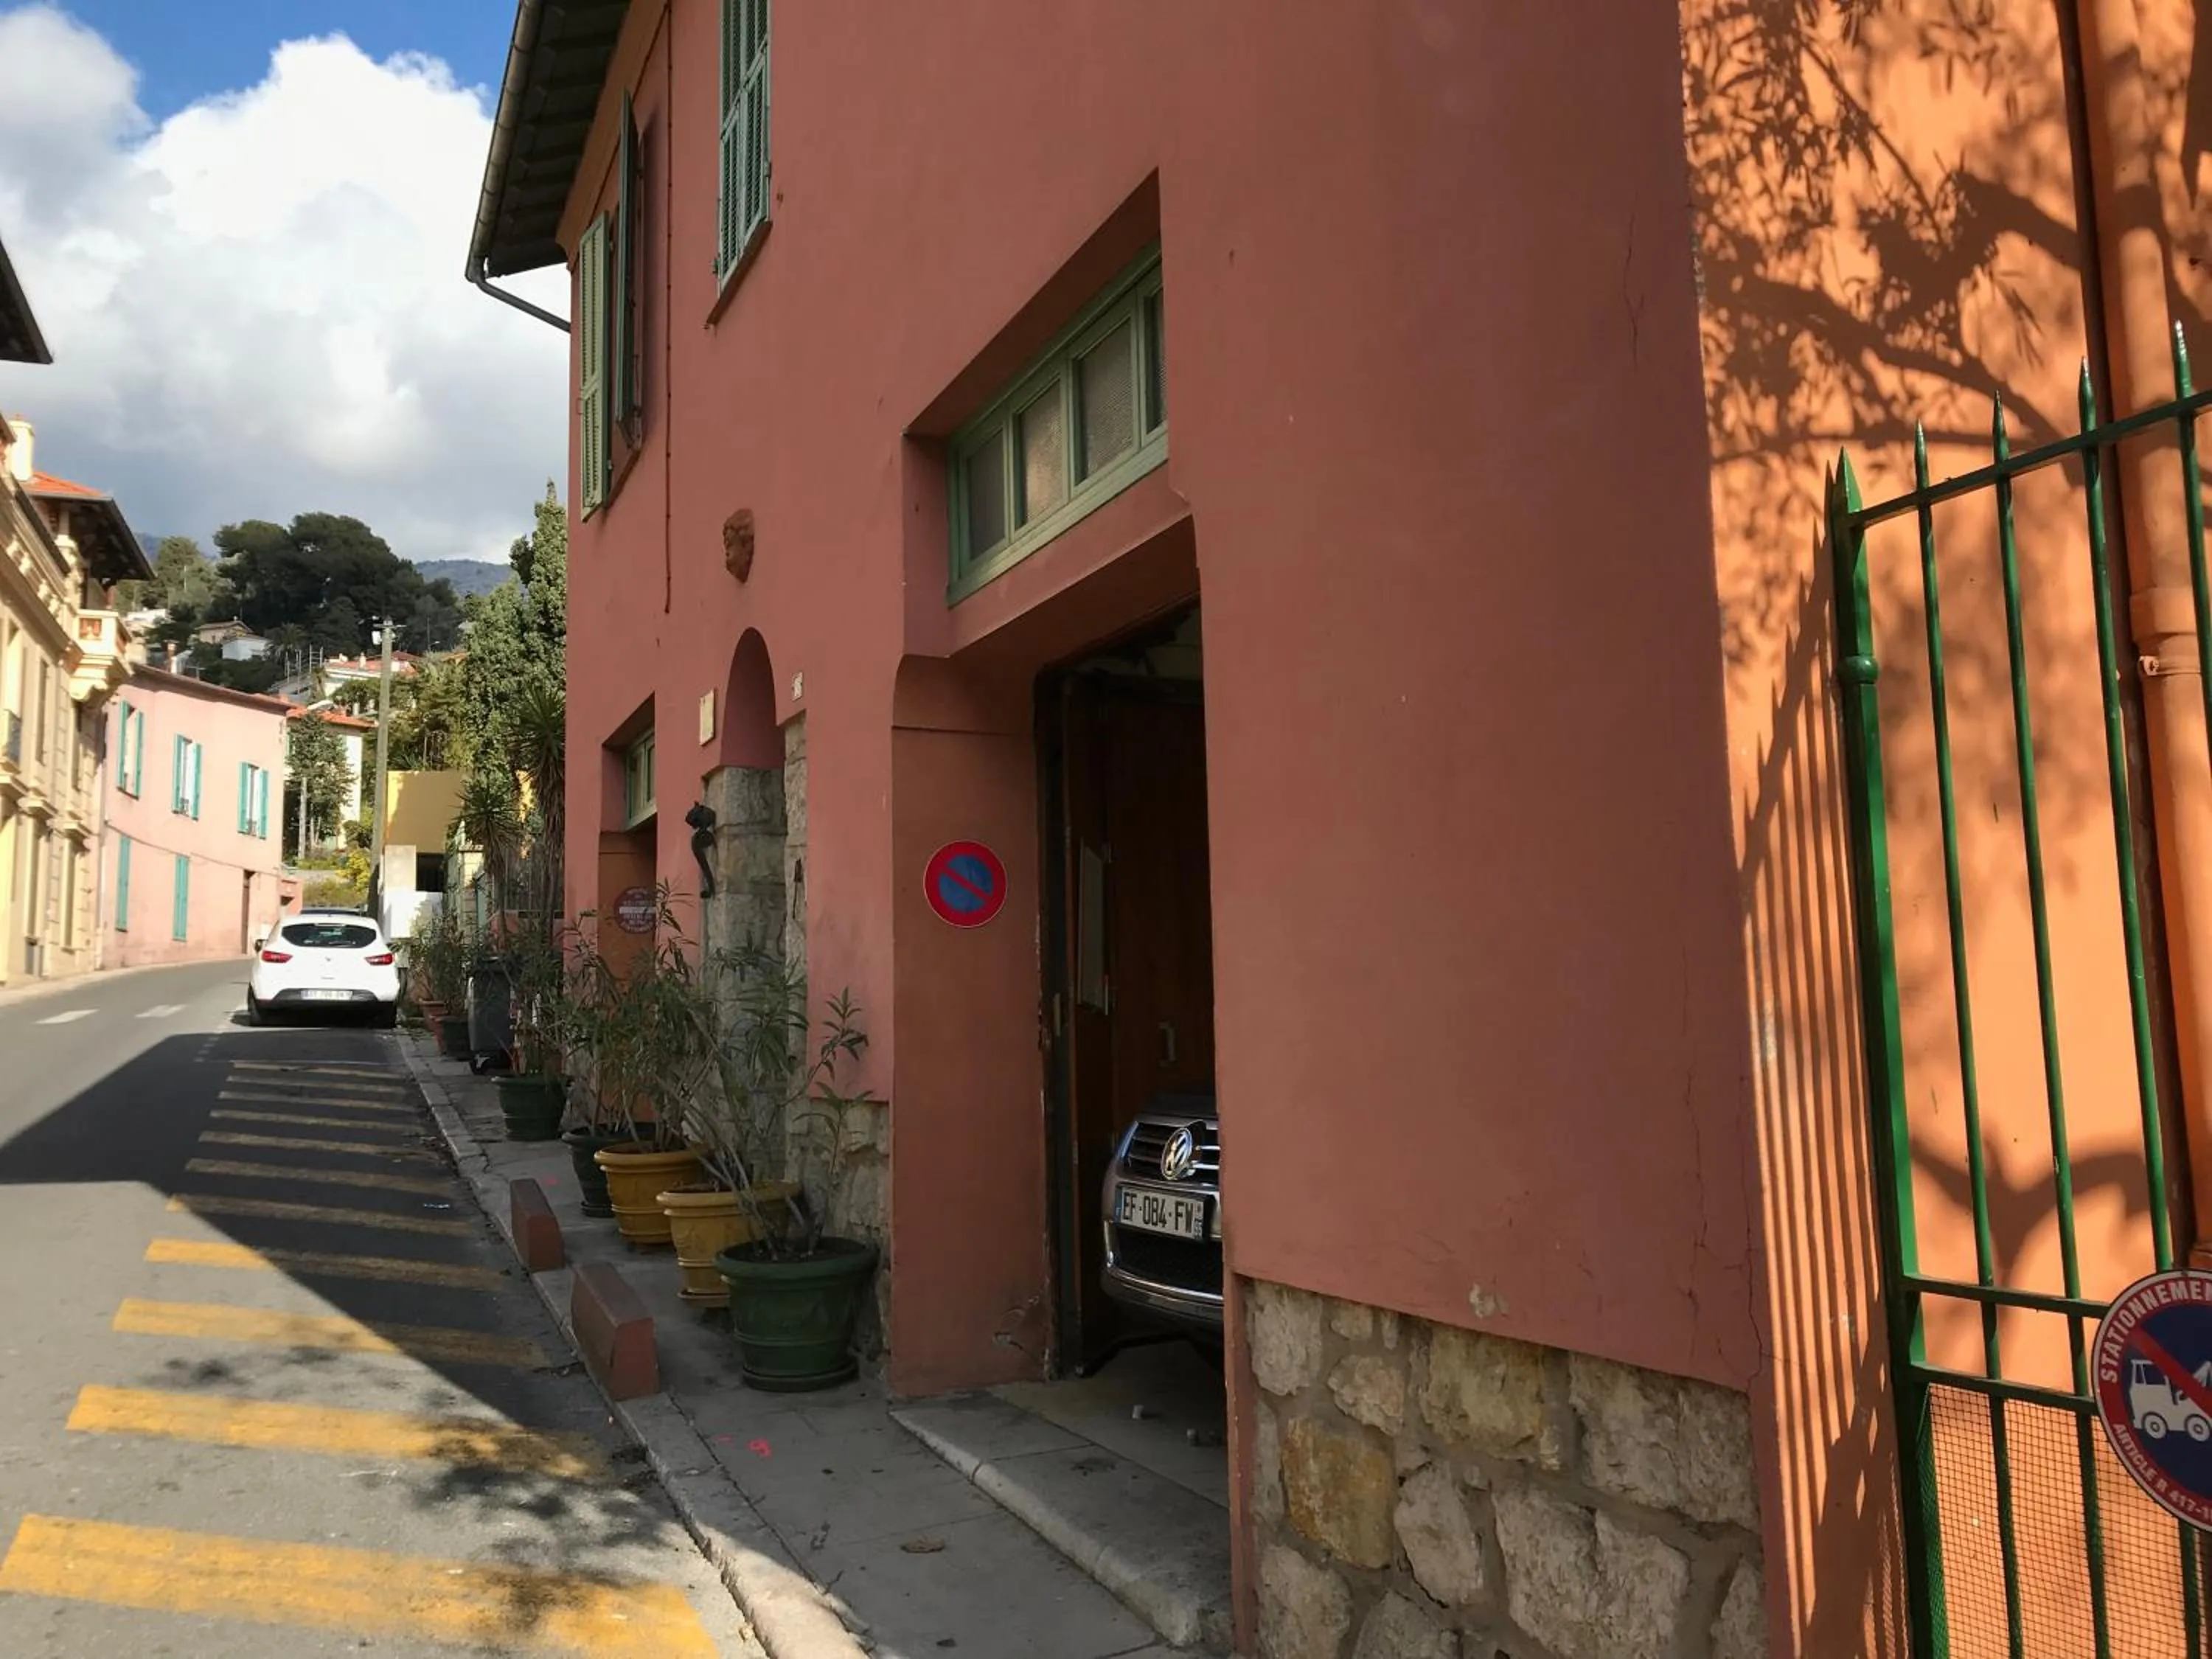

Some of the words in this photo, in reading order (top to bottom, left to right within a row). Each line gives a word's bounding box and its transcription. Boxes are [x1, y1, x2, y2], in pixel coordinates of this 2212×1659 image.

[2112, 1423, 2158, 1481] ARTICLE
[2155, 1478, 2168, 1492] R
[2168, 1490, 2212, 1520] 417-1
